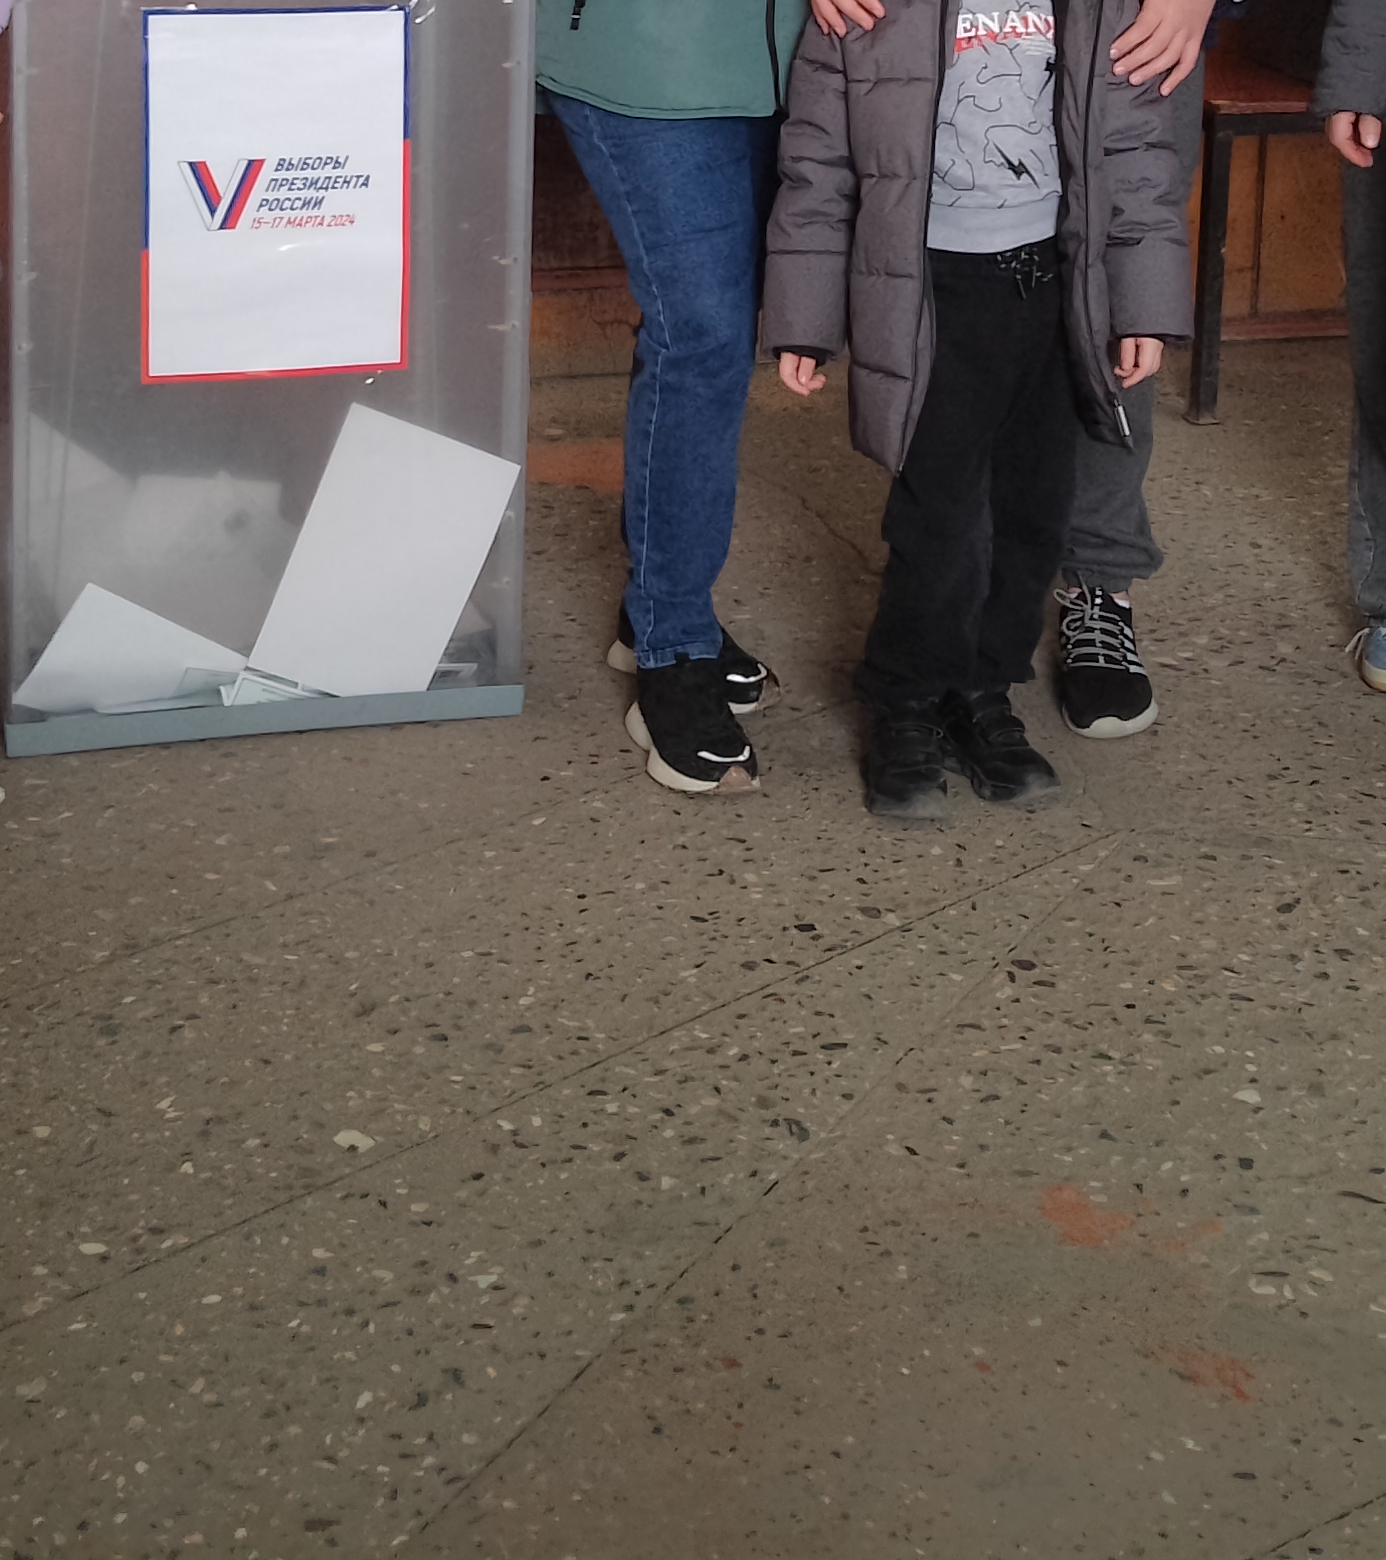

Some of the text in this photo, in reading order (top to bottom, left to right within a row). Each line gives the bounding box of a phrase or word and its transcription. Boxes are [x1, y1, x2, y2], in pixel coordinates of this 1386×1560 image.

[274, 155, 349, 172] ВЫБОРЫ
[265, 174, 371, 193] ПРЕЗИДЕНТА
[256, 195, 326, 213] РОССИИ
[284, 215, 326, 229] МАРТА
[327, 213, 356, 228] 2024
